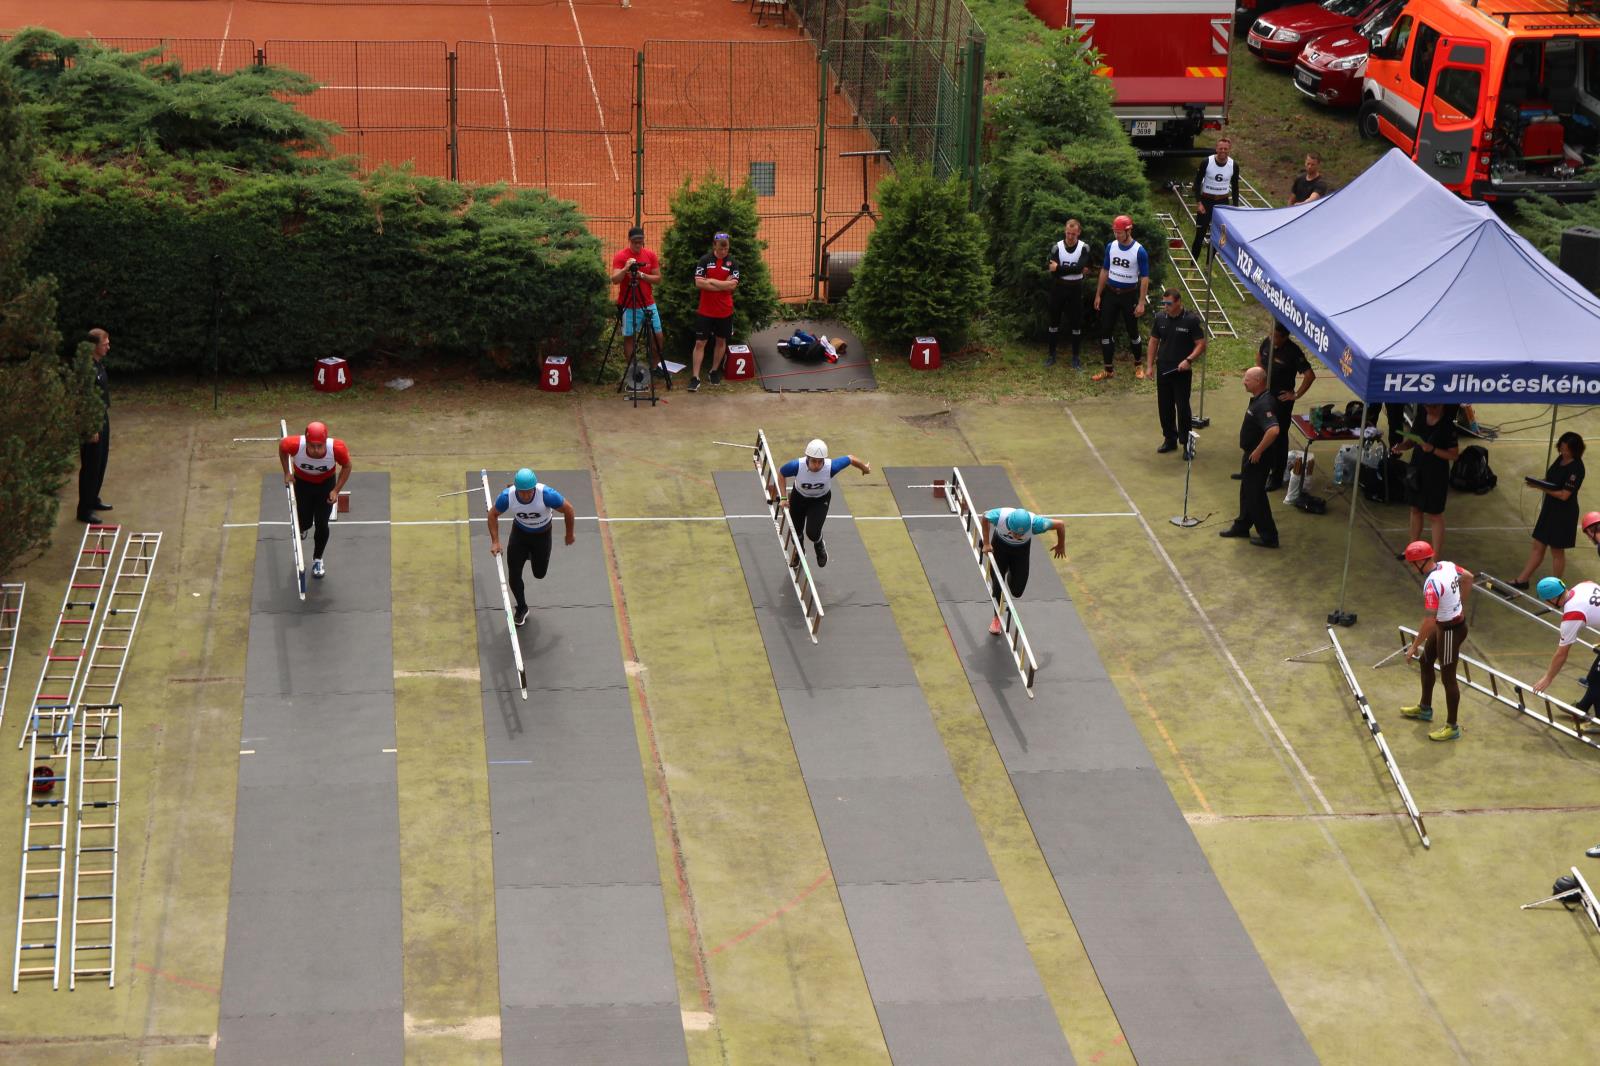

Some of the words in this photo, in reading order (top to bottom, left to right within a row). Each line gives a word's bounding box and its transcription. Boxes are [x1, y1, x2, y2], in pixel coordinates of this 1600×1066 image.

[1214, 173, 1224, 183] 6
[1111, 256, 1131, 269] 88
[1236, 246, 1254, 278] HZS
[1303, 312, 1329, 353] kraje
[922, 348, 930, 365] 1
[735, 358, 746, 375] 2
[317, 367, 325, 385] 4
[337, 367, 346, 385] 4
[549, 369, 560, 386] 3
[1384, 373, 1436, 392] HZS
[1443, 373, 1600, 394] Jihočeského
